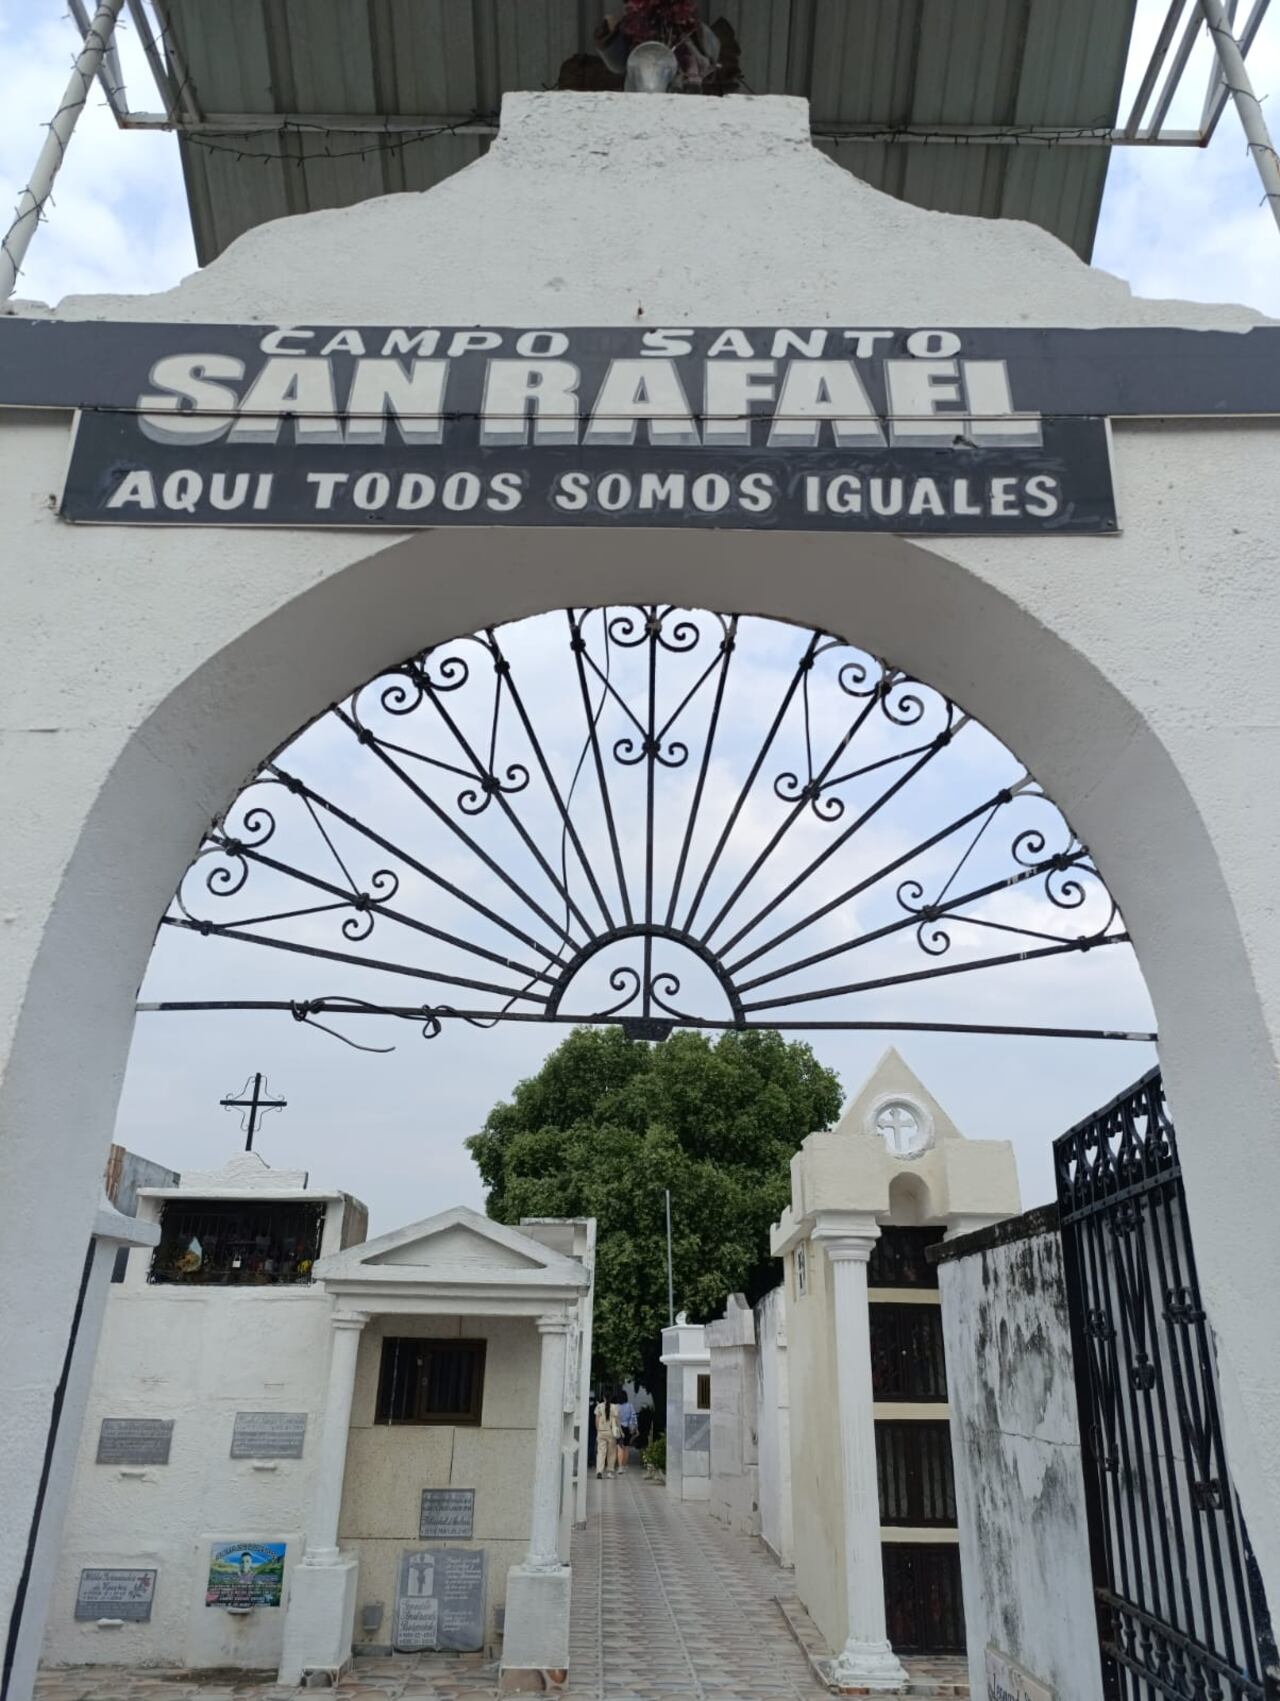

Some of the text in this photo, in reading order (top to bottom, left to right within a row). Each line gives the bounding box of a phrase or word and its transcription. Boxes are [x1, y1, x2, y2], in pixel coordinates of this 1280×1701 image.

[259, 328, 962, 359] CAMPO SANTO
[137, 352, 1044, 449] SAN RAFAEL
[107, 470, 1059, 518] AQUI TODOS SOMOS IGUALES
